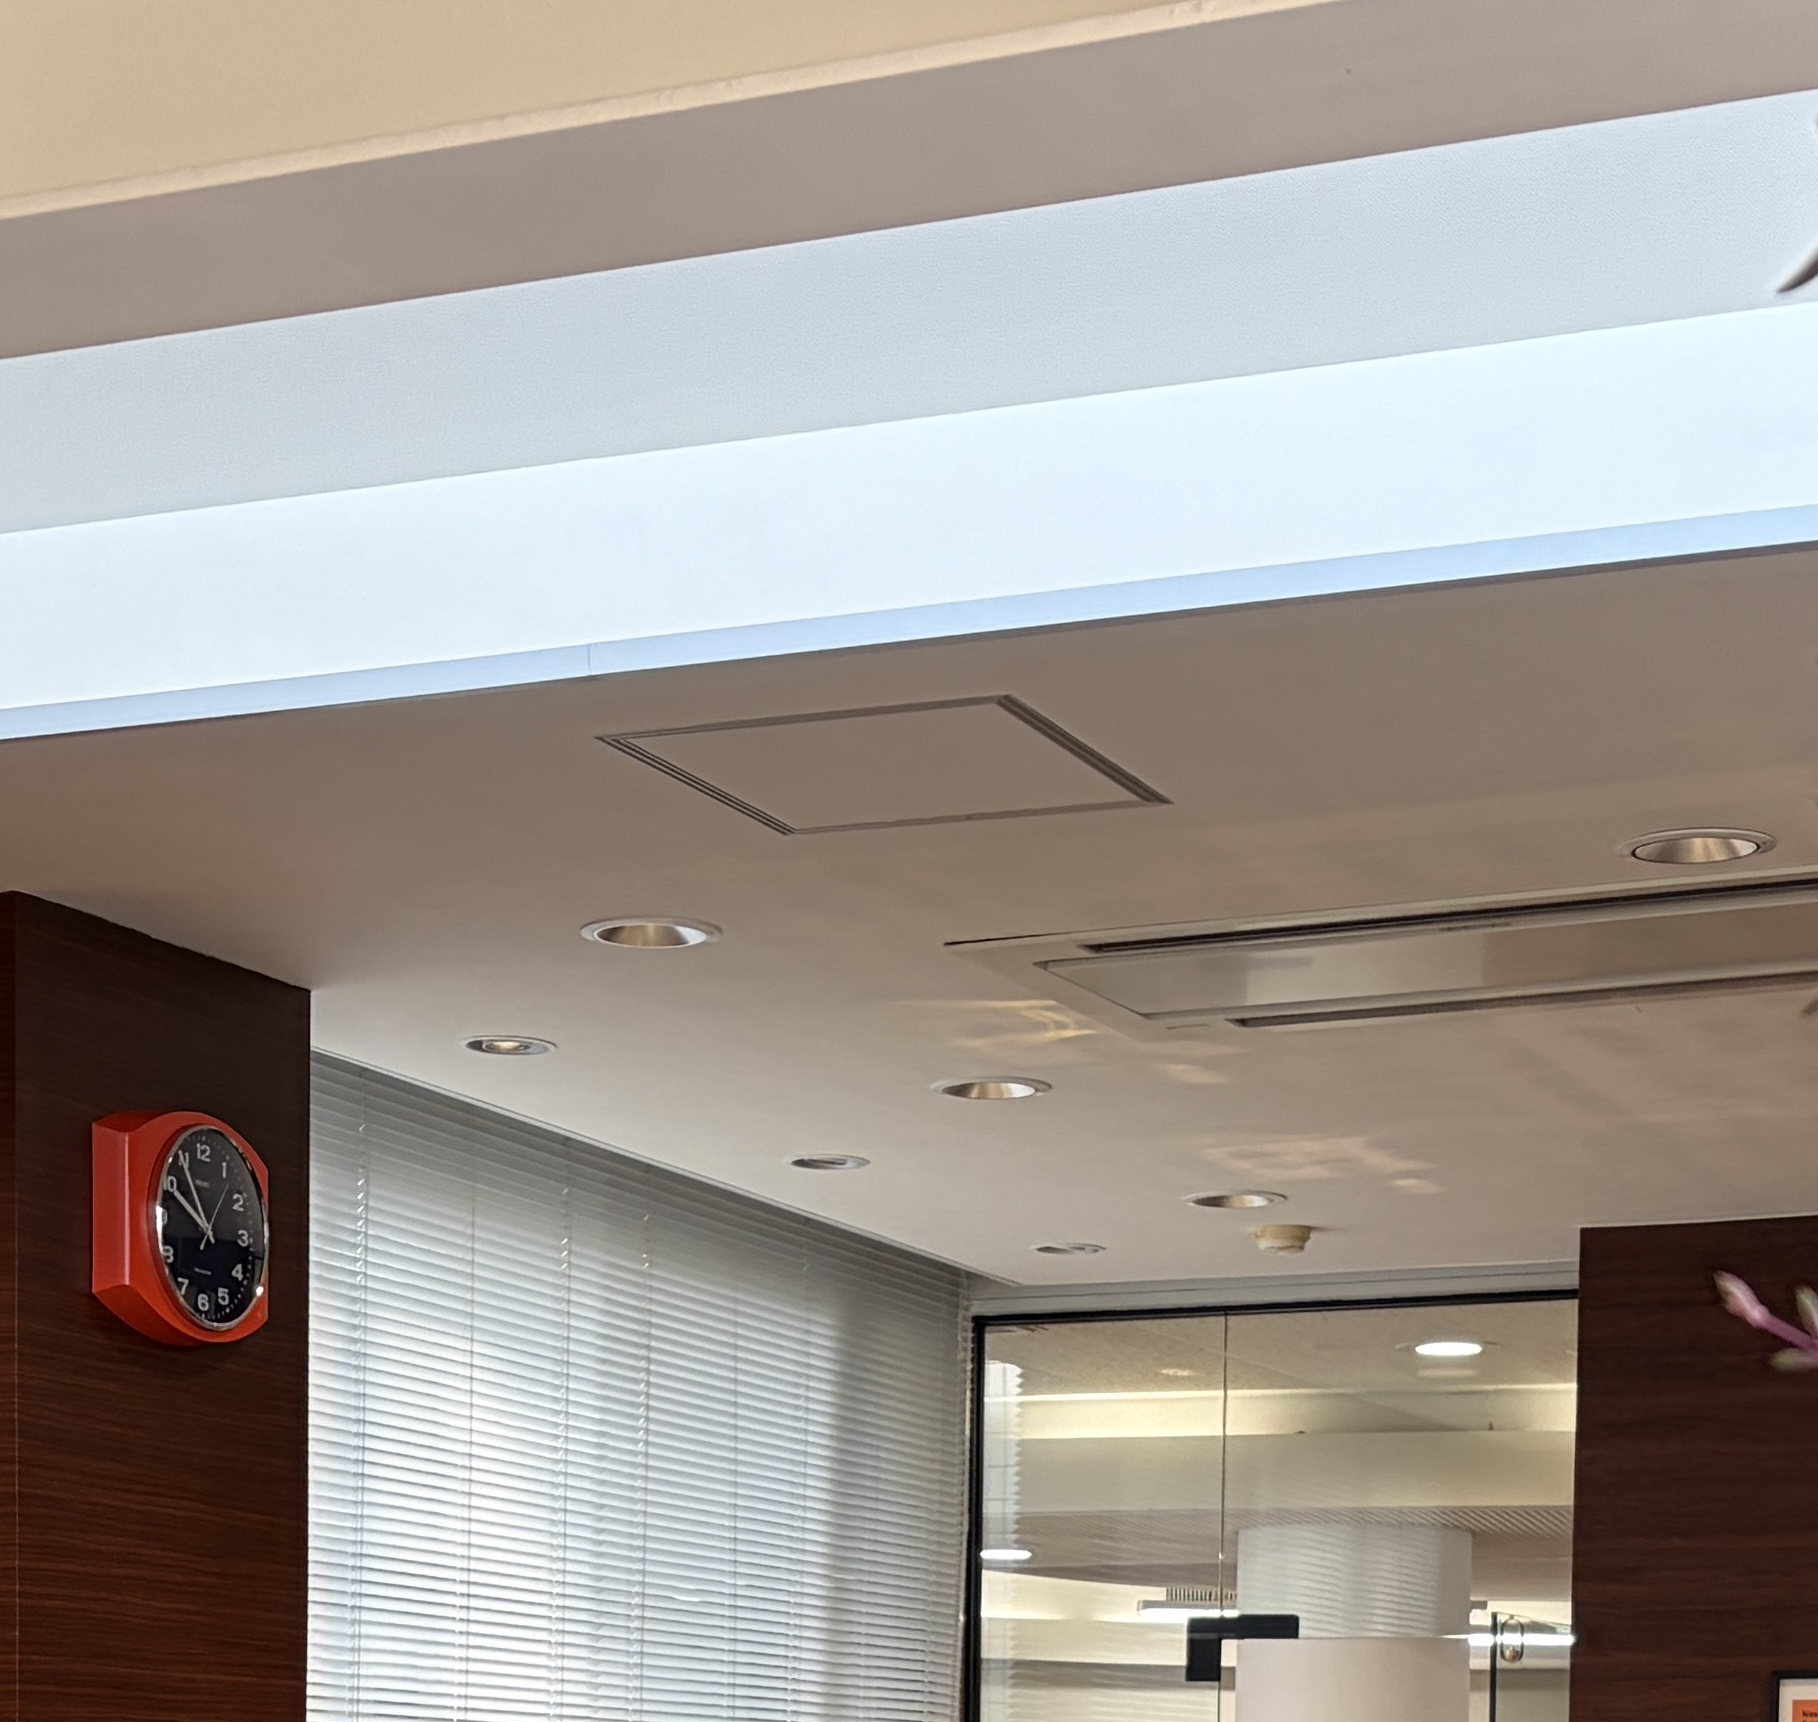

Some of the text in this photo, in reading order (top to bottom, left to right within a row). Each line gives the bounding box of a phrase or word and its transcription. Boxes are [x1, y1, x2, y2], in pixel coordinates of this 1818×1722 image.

[196, 1143, 212, 1162] 12
[221, 1161, 228, 1179] 1
[163, 1175, 178, 1192] 10
[232, 1193, 245, 1212] 2
[237, 1229, 250, 1248] 3
[161, 1245, 175, 1264] 8
[231, 1263, 244, 1282] 4
[177, 1277, 190, 1295] 7
[197, 1293, 210, 1312] 6
[217, 1287, 230, 1306] 5
